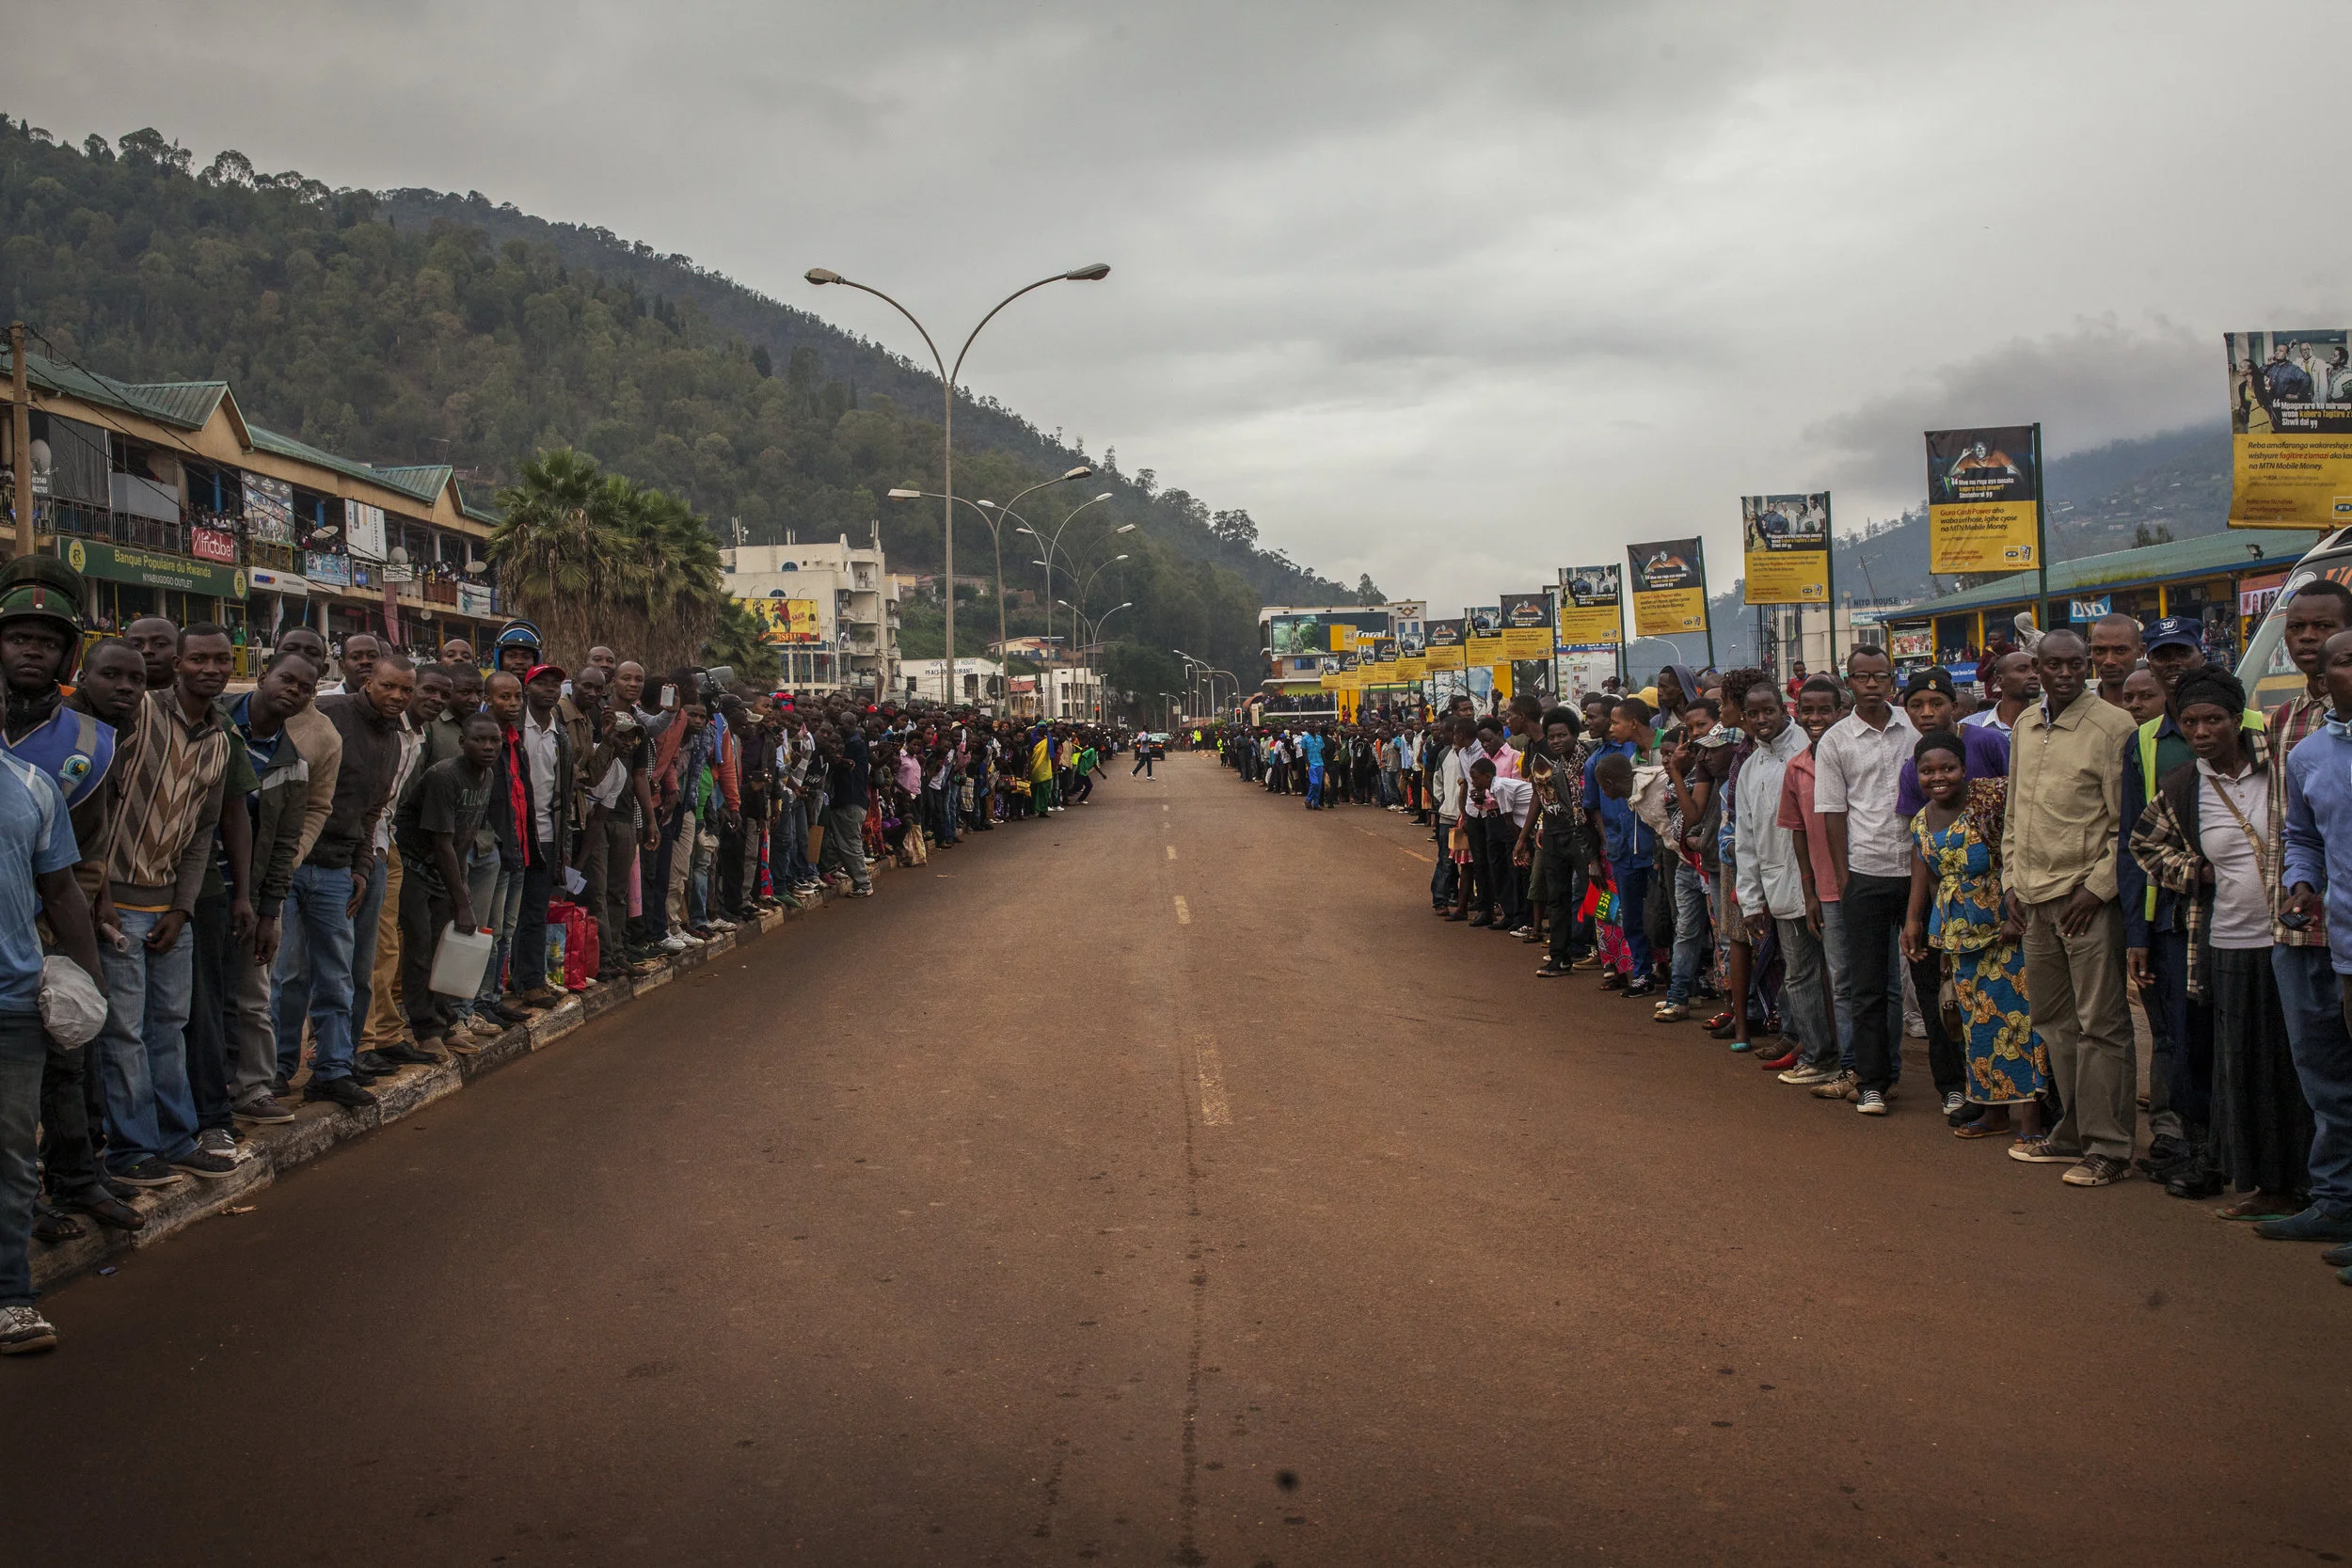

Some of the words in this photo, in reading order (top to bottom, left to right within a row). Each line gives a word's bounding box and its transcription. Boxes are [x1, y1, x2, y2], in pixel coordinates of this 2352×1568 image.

[2266, 441, 2308, 451] amafaranga
[1986, 523, 2009, 531] Money.
[193, 531, 233, 558] Africabet
[114, 549, 142, 568] Banque
[143, 555, 175, 572] Populaire
[176, 562, 185, 574] du
[186, 562, 212, 578] Rwanda
[142, 573, 174, 586] NYABUGOGO
[175, 578, 193, 589] OUTLET
[1873, 597, 1898, 606] HOUSE
[791, 611, 805, 621] SKOL
[1598, 892, 1611, 909] SEE
